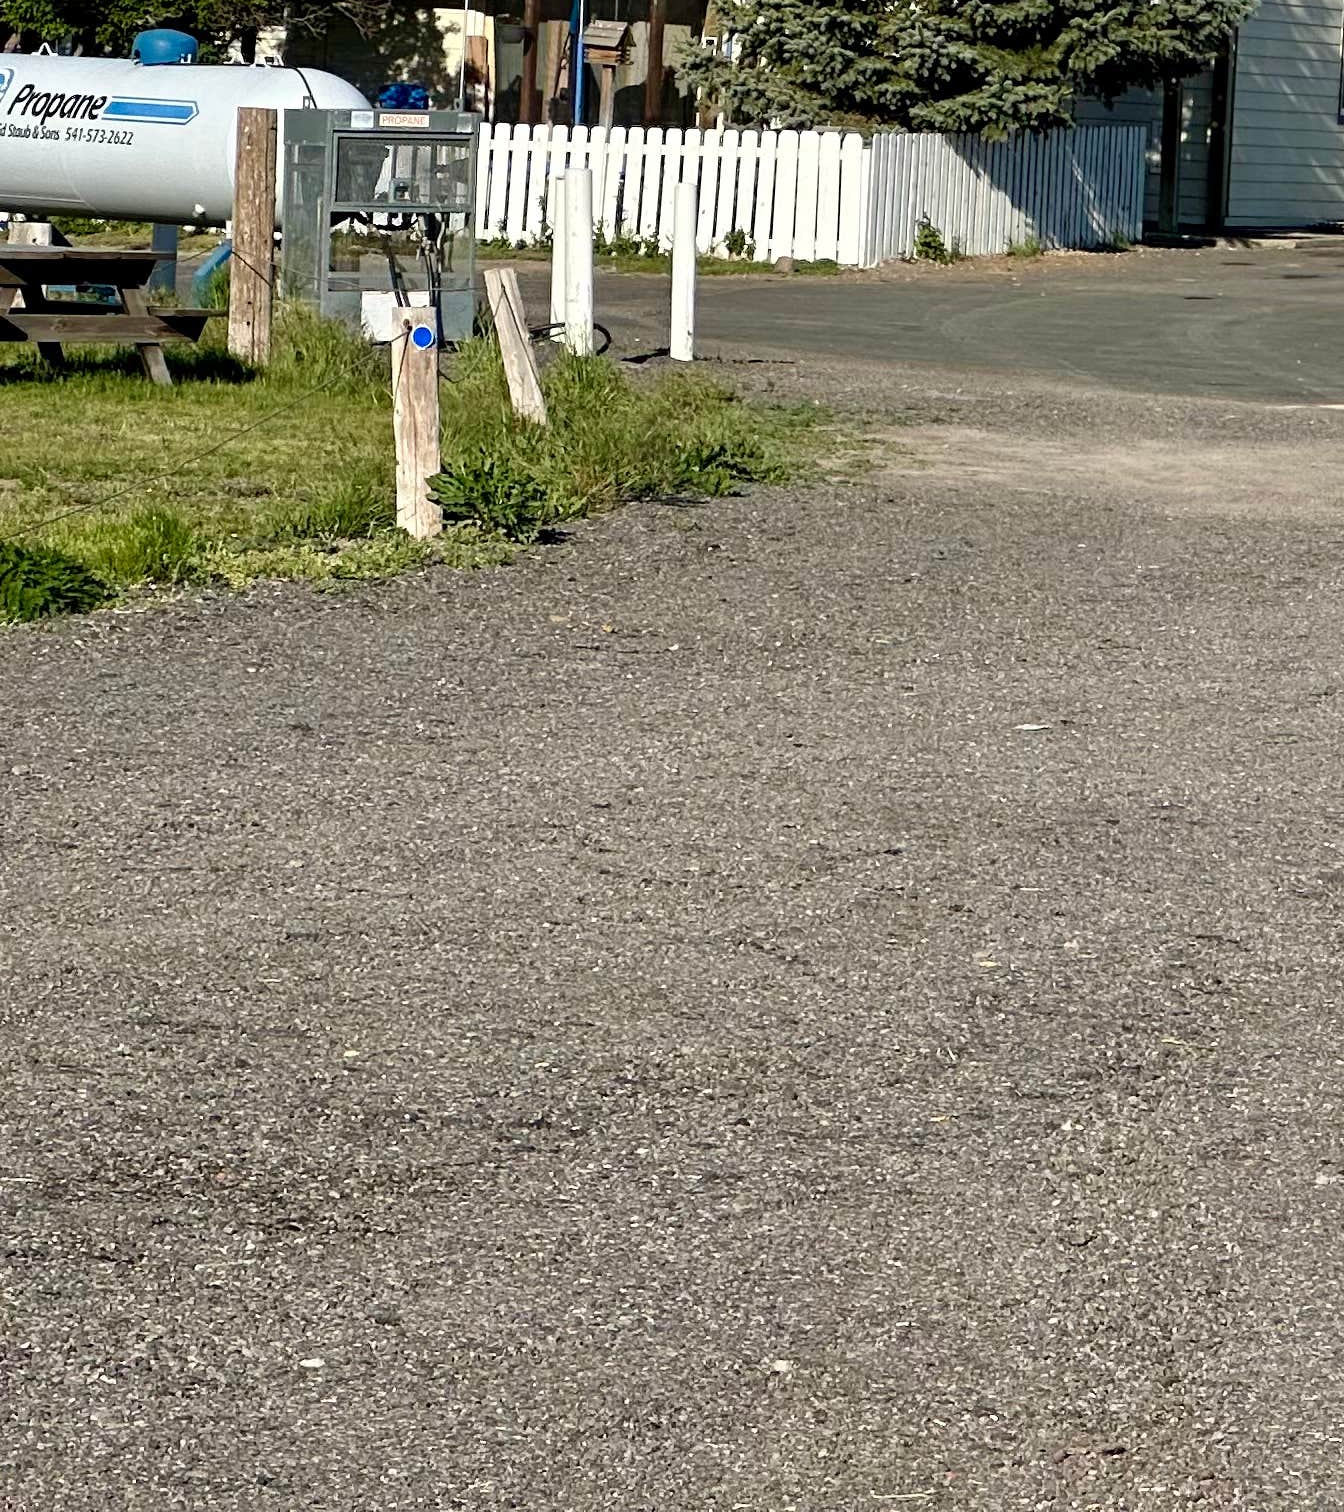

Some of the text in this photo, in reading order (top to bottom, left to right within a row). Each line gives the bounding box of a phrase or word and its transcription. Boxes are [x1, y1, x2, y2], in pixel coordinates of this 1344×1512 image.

[7, 84, 107, 125] Propane
[382, 116, 426, 124] PROPANE
[32, 125, 39, 139] &
[65, 127, 134, 146] 541-573-2622
